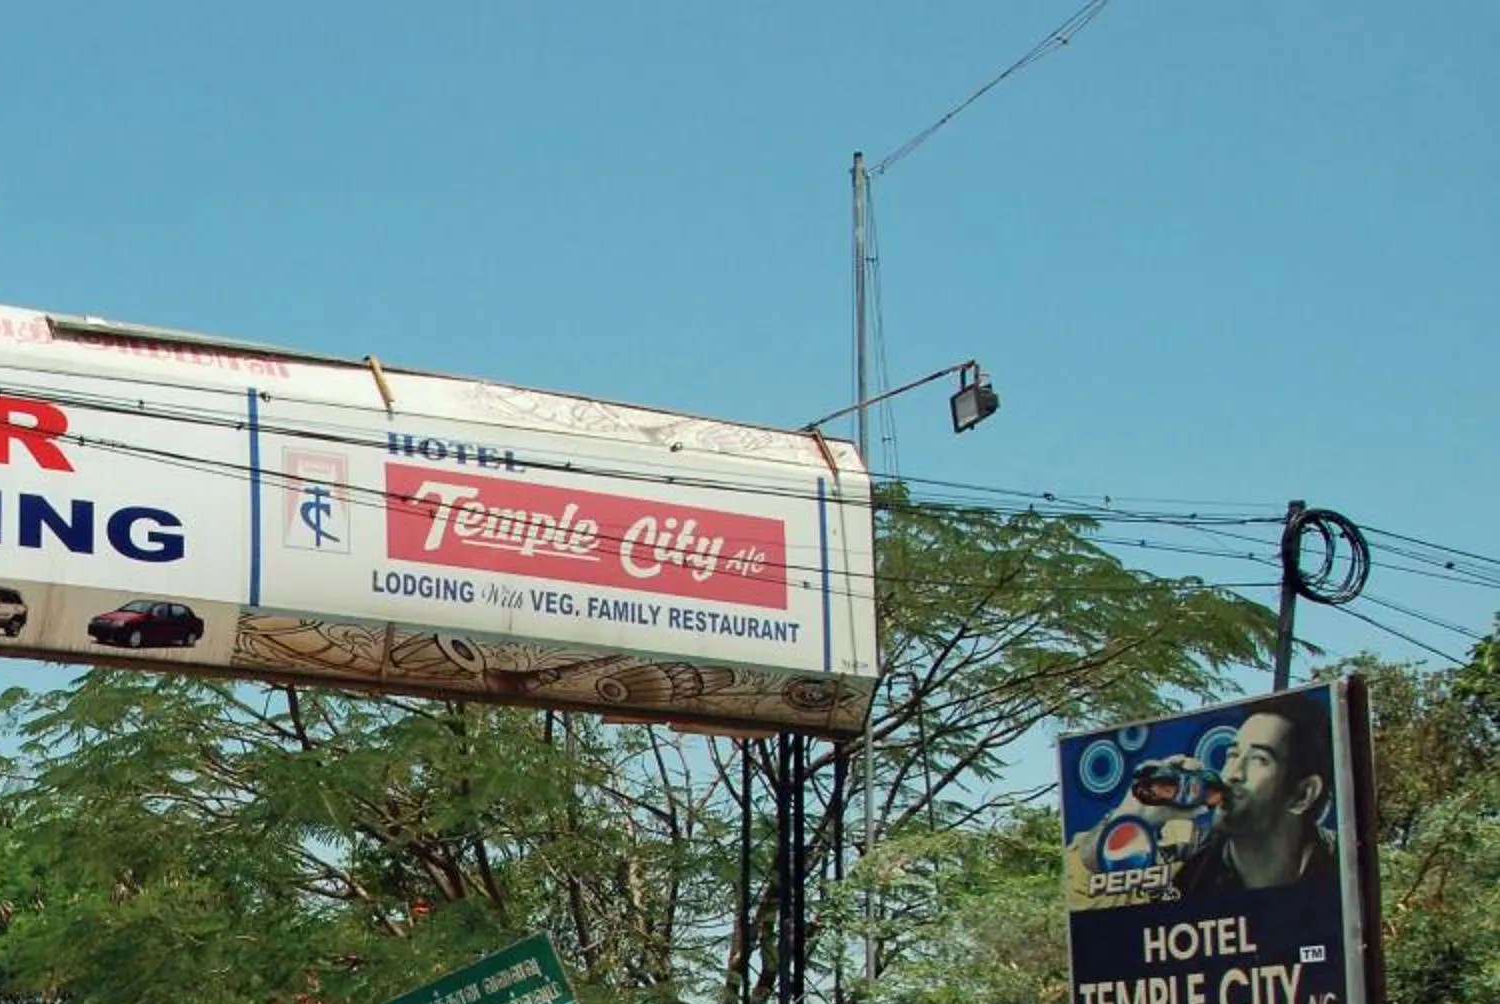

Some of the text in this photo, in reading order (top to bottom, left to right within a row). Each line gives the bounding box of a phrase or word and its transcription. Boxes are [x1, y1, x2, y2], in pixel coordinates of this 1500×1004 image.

[388, 431, 526, 473] HOTEL
[410, 481, 602, 562] Temple
[620, 515, 727, 582] City
[372, 569, 800, 643] LODGING With VEG. FAMILY RESTAURANT
[1089, 864, 1170, 898] PEPSI
[1143, 916, 1257, 963] HOTEL
[1302, 947, 1325, 961] TM
